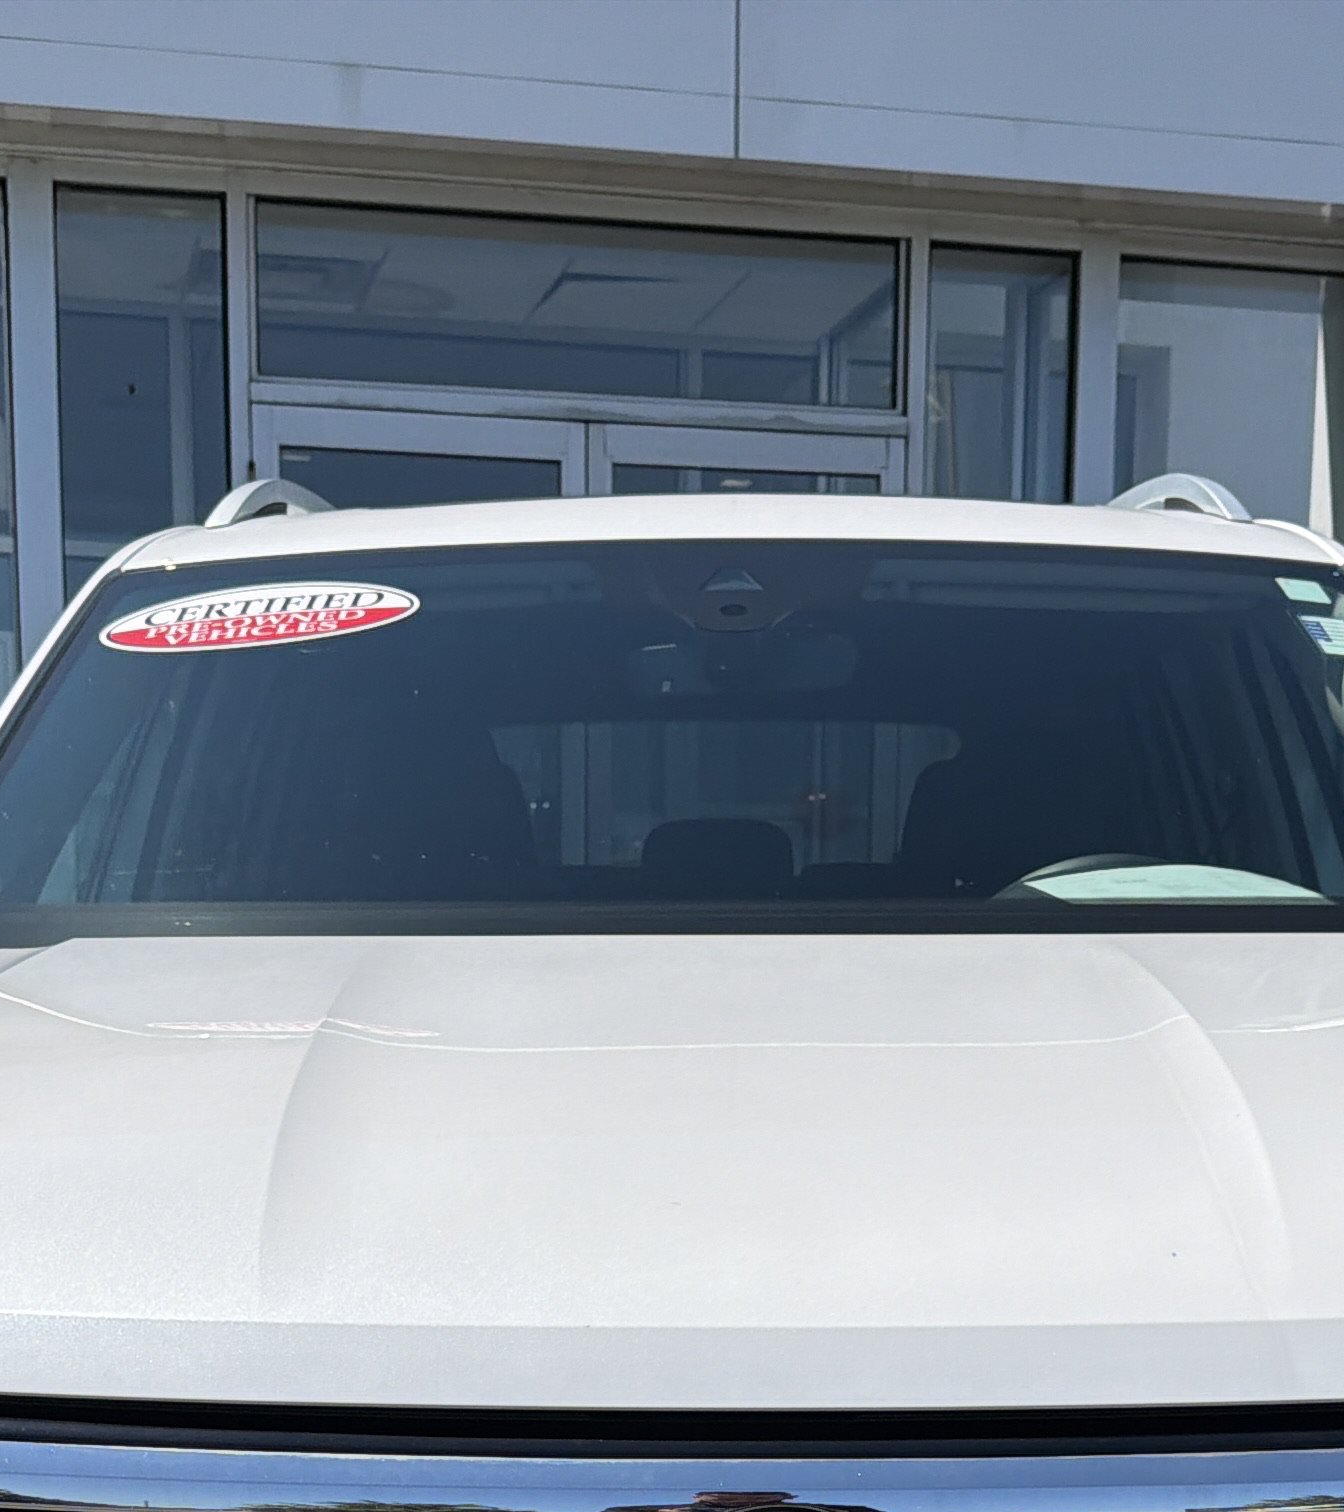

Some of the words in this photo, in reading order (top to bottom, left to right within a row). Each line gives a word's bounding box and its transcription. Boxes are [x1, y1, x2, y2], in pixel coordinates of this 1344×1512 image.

[144, 591, 385, 627] CERTIFIED
[145, 610, 367, 639] PRE-OWNED
[165, 621, 339, 645] VEHICLES
